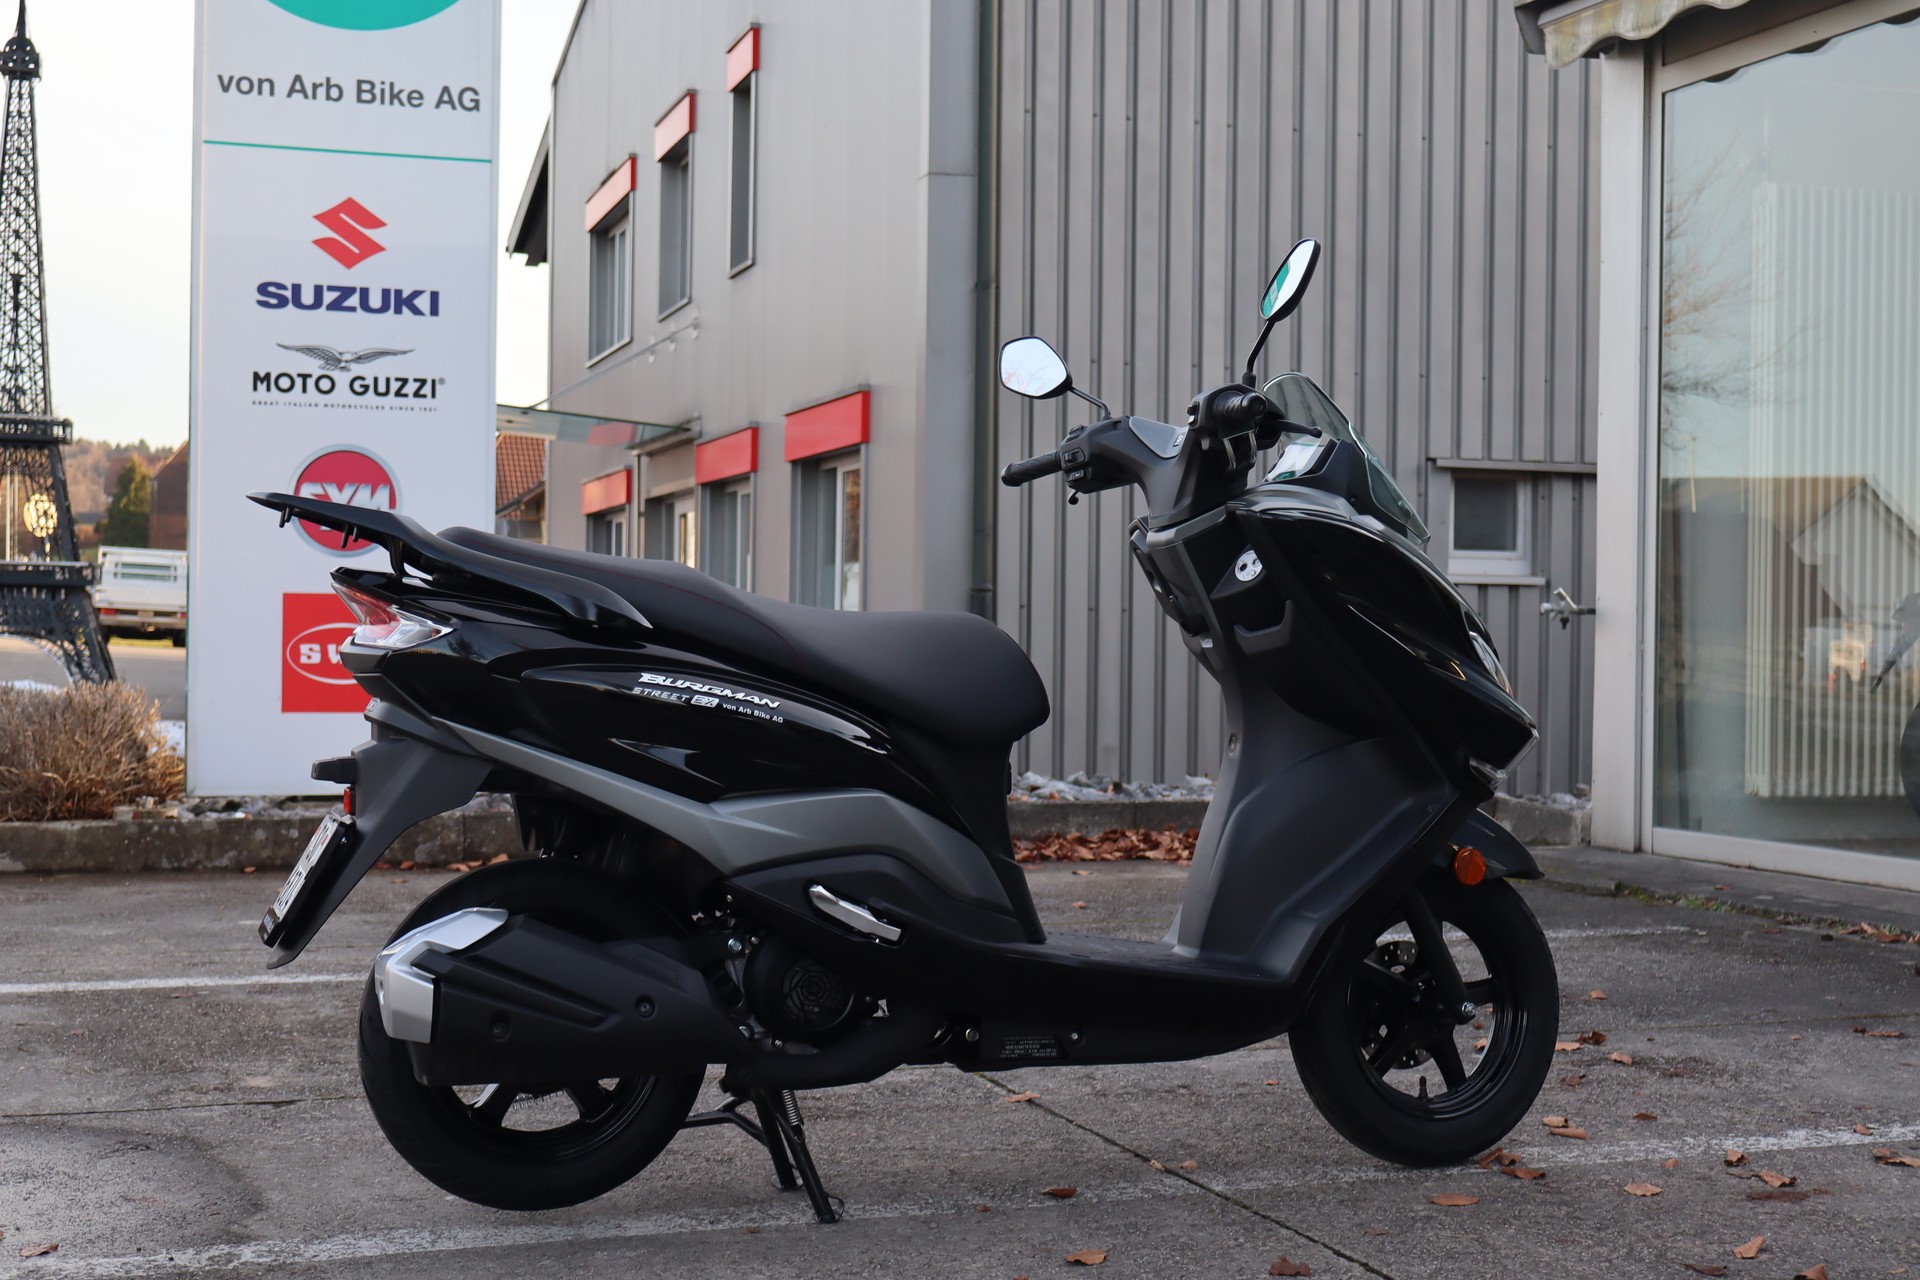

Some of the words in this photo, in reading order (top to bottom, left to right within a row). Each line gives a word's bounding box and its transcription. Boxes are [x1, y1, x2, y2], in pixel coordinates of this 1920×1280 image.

[217, 74, 275, 97] von
[286, 74, 344, 102] Arb
[356, 79, 424, 108] Bike
[434, 86, 481, 112] AG
[256, 281, 440, 317] SUZUKI
[252, 371, 336, 395] MOTO
[631, 686, 690, 702] STREET
[638, 672, 781, 709] BURGMAN
[722, 702, 737, 712] von
[738, 705, 752, 715] Arb
[753, 709, 770, 720] Bike
[772, 714, 784, 723] AG
